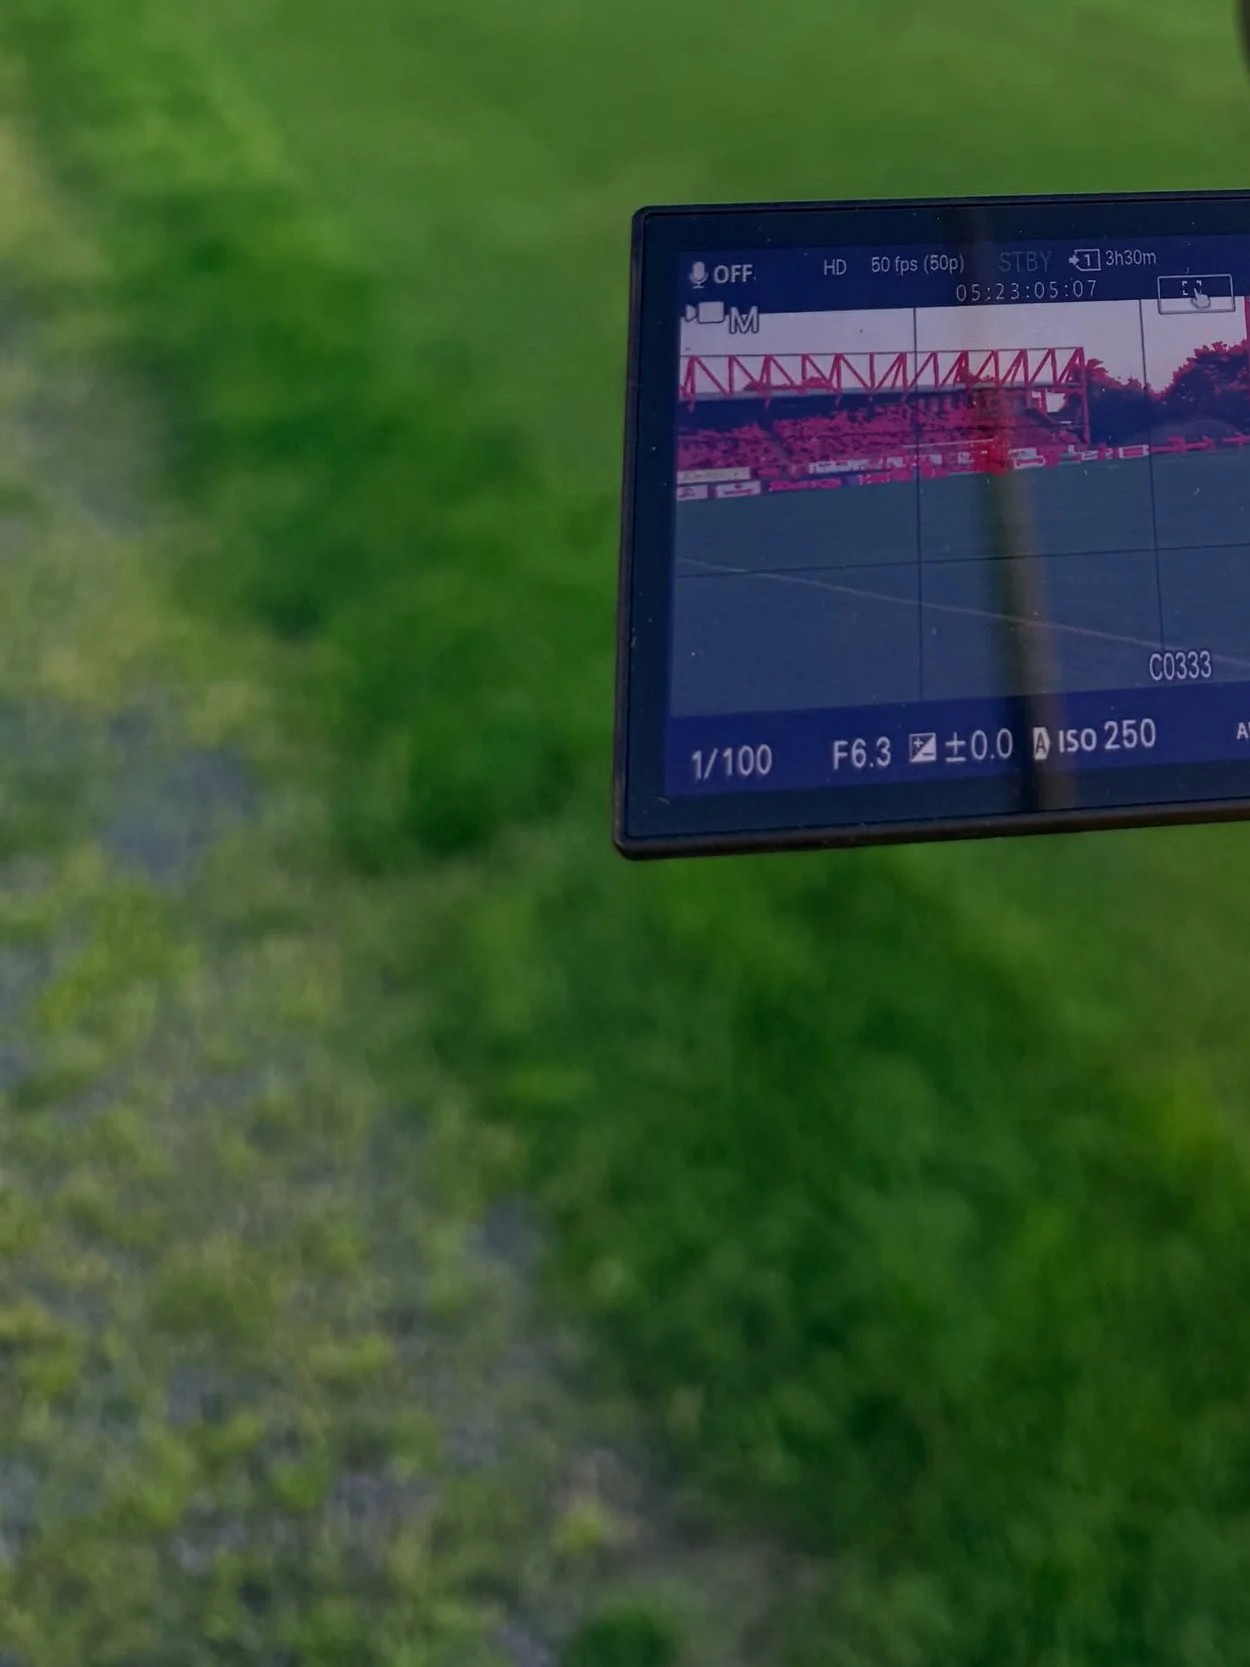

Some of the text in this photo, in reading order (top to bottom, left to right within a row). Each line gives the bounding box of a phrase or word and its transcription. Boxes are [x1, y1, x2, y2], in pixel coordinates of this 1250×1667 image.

[823, 258, 847, 276] HD
[871, 254, 965, 277] 50 fps (50p)
[999, 249, 1054, 272] STBY
[1105, 249, 1158, 266] 3h30m
[713, 264, 753, 283] OFF
[956, 279, 1097, 302] 05:23:05:07
[729, 305, 760, 335] M
[1149, 650, 1212, 681] C0333
[944, 727, 1015, 764] ±0.0
[1104, 717, 1157, 750] 250
[690, 742, 773, 780] 1/100
[831, 736, 893, 770] F6.3
